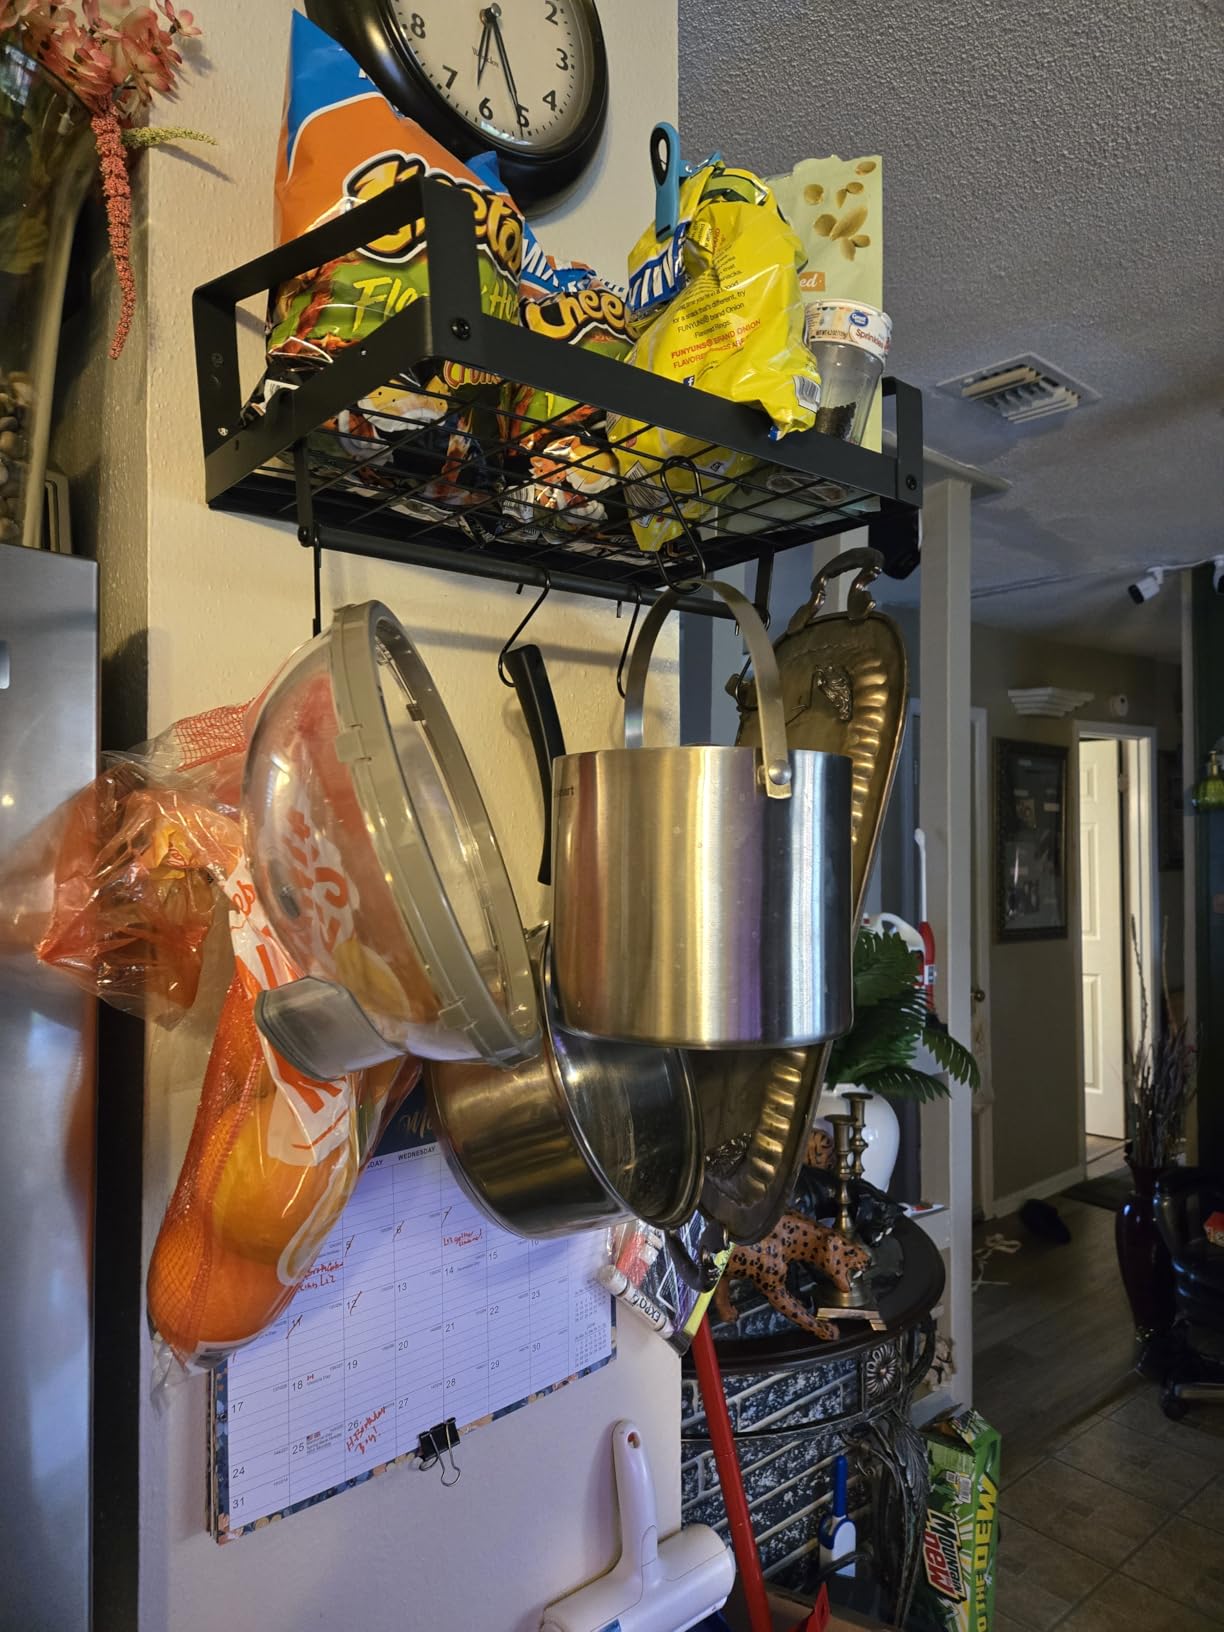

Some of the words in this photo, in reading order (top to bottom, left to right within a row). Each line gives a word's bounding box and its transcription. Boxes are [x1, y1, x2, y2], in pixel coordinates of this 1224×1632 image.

[545, 0, 560, 25] 2
[410, 13, 426, 39] 8
[555, 48, 569, 72] 3
[441, 65, 458, 90] 7
[542, 89, 558, 111] 4
[479, 98, 494, 120] 6
[517, 105, 530, 128] 5
[488, 1251, 498, 1260] 15
[444, 1266, 454, 1275] 14
[397, 1282, 407, 1292] 13
[532, 1290, 541, 1299] 23
[489, 1305, 499, 1315] 22
[446, 1323, 455, 1332] 21
[398, 1340, 409, 1350] 20
[532, 1342, 541, 1352] 30
[347, 1360, 358, 1370] 19
[491, 1360, 500, 1369] 29
[293, 1380, 303, 1391] 18
[446, 1379, 456, 1389] 28
[231, 1402, 244, 1413] 17
[399, 1398, 409, 1409] 27
[348, 1420, 359, 1431] 26
[293, 1444, 305, 1455] 25
[232, 1467, 245, 1478] 24
[233, 1497, 245, 1509] 31
[975, 1473, 997, 1569] DEW
[976, 1573, 986, 1613] THE
